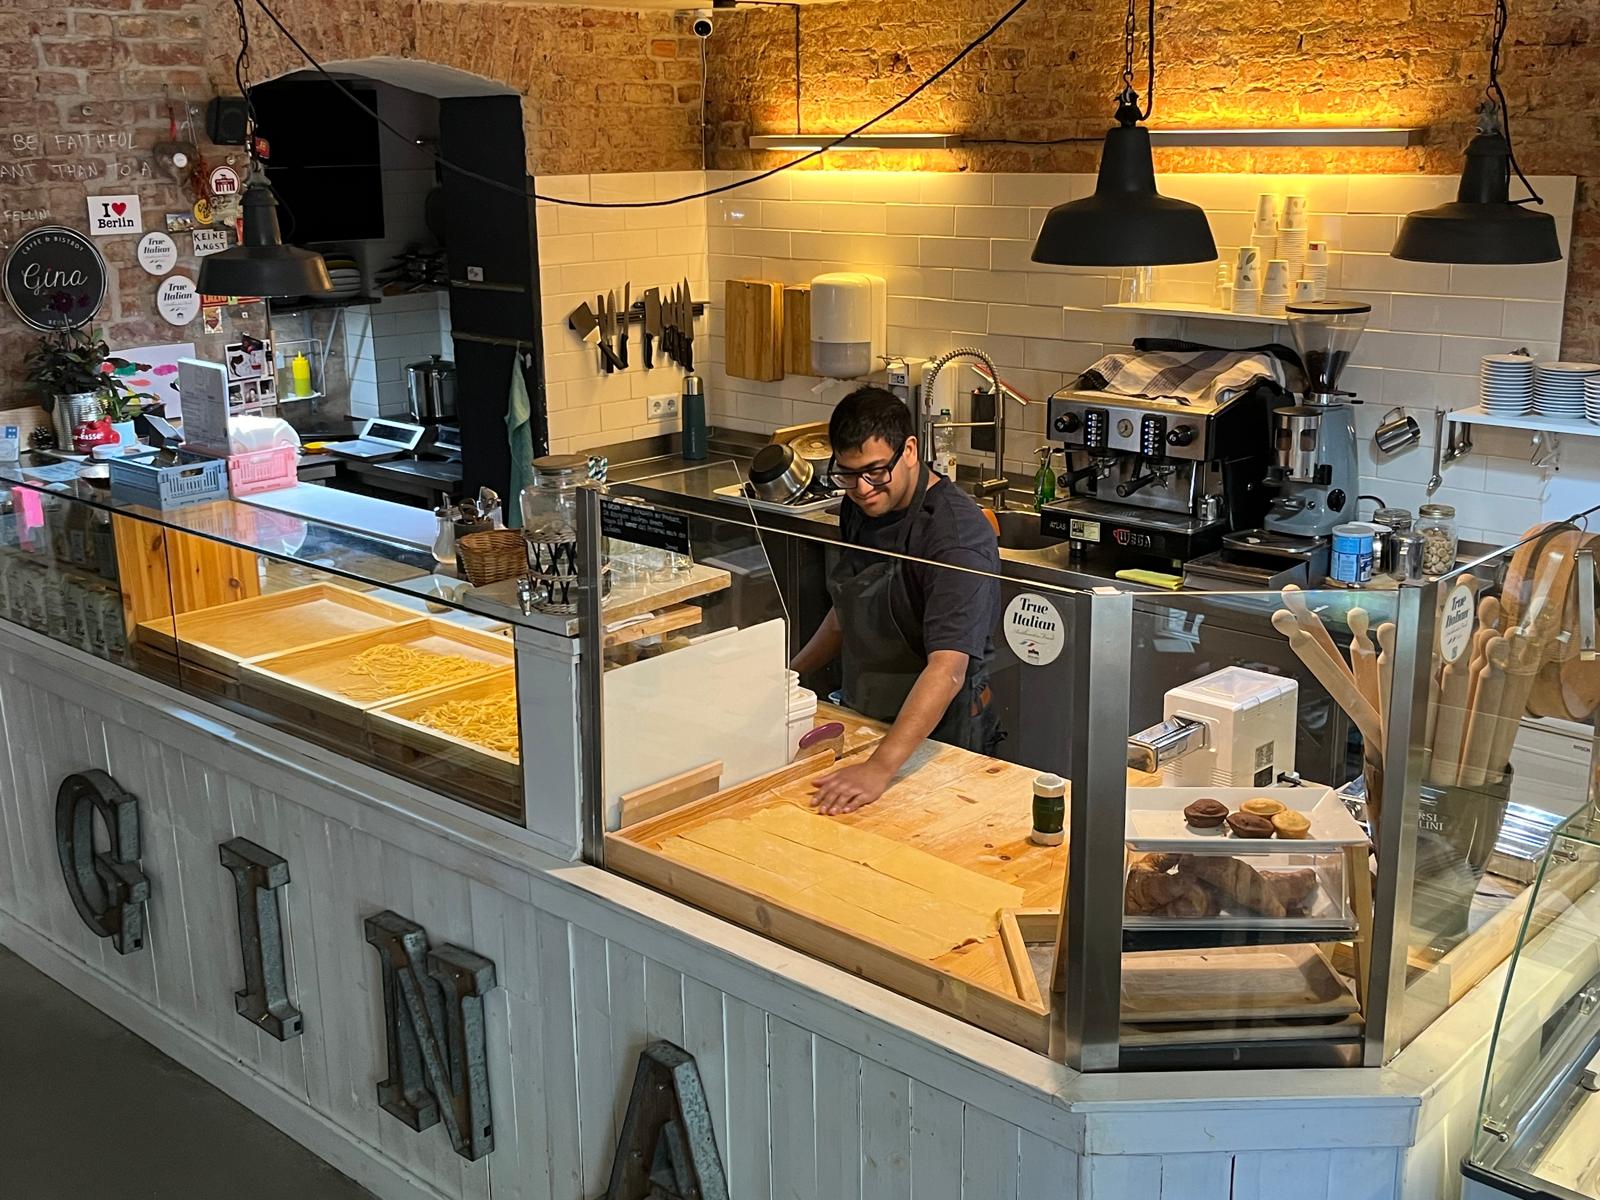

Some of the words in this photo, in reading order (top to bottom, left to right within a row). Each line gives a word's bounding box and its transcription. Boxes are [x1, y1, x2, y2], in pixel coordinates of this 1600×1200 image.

[13, 134, 38, 150] BE
[55, 133, 139, 150] FAITHFUL
[101, 203, 112, 217] I
[97, 217, 135, 228] Berlin
[148, 237, 166, 245] True
[143, 245, 171, 254] Italian
[21, 262, 88, 296] Gina
[168, 283, 188, 292] True
[163, 292, 193, 301] Italian
[1020, 597, 1049, 615] True
[1012, 612, 1056, 631] Italian
